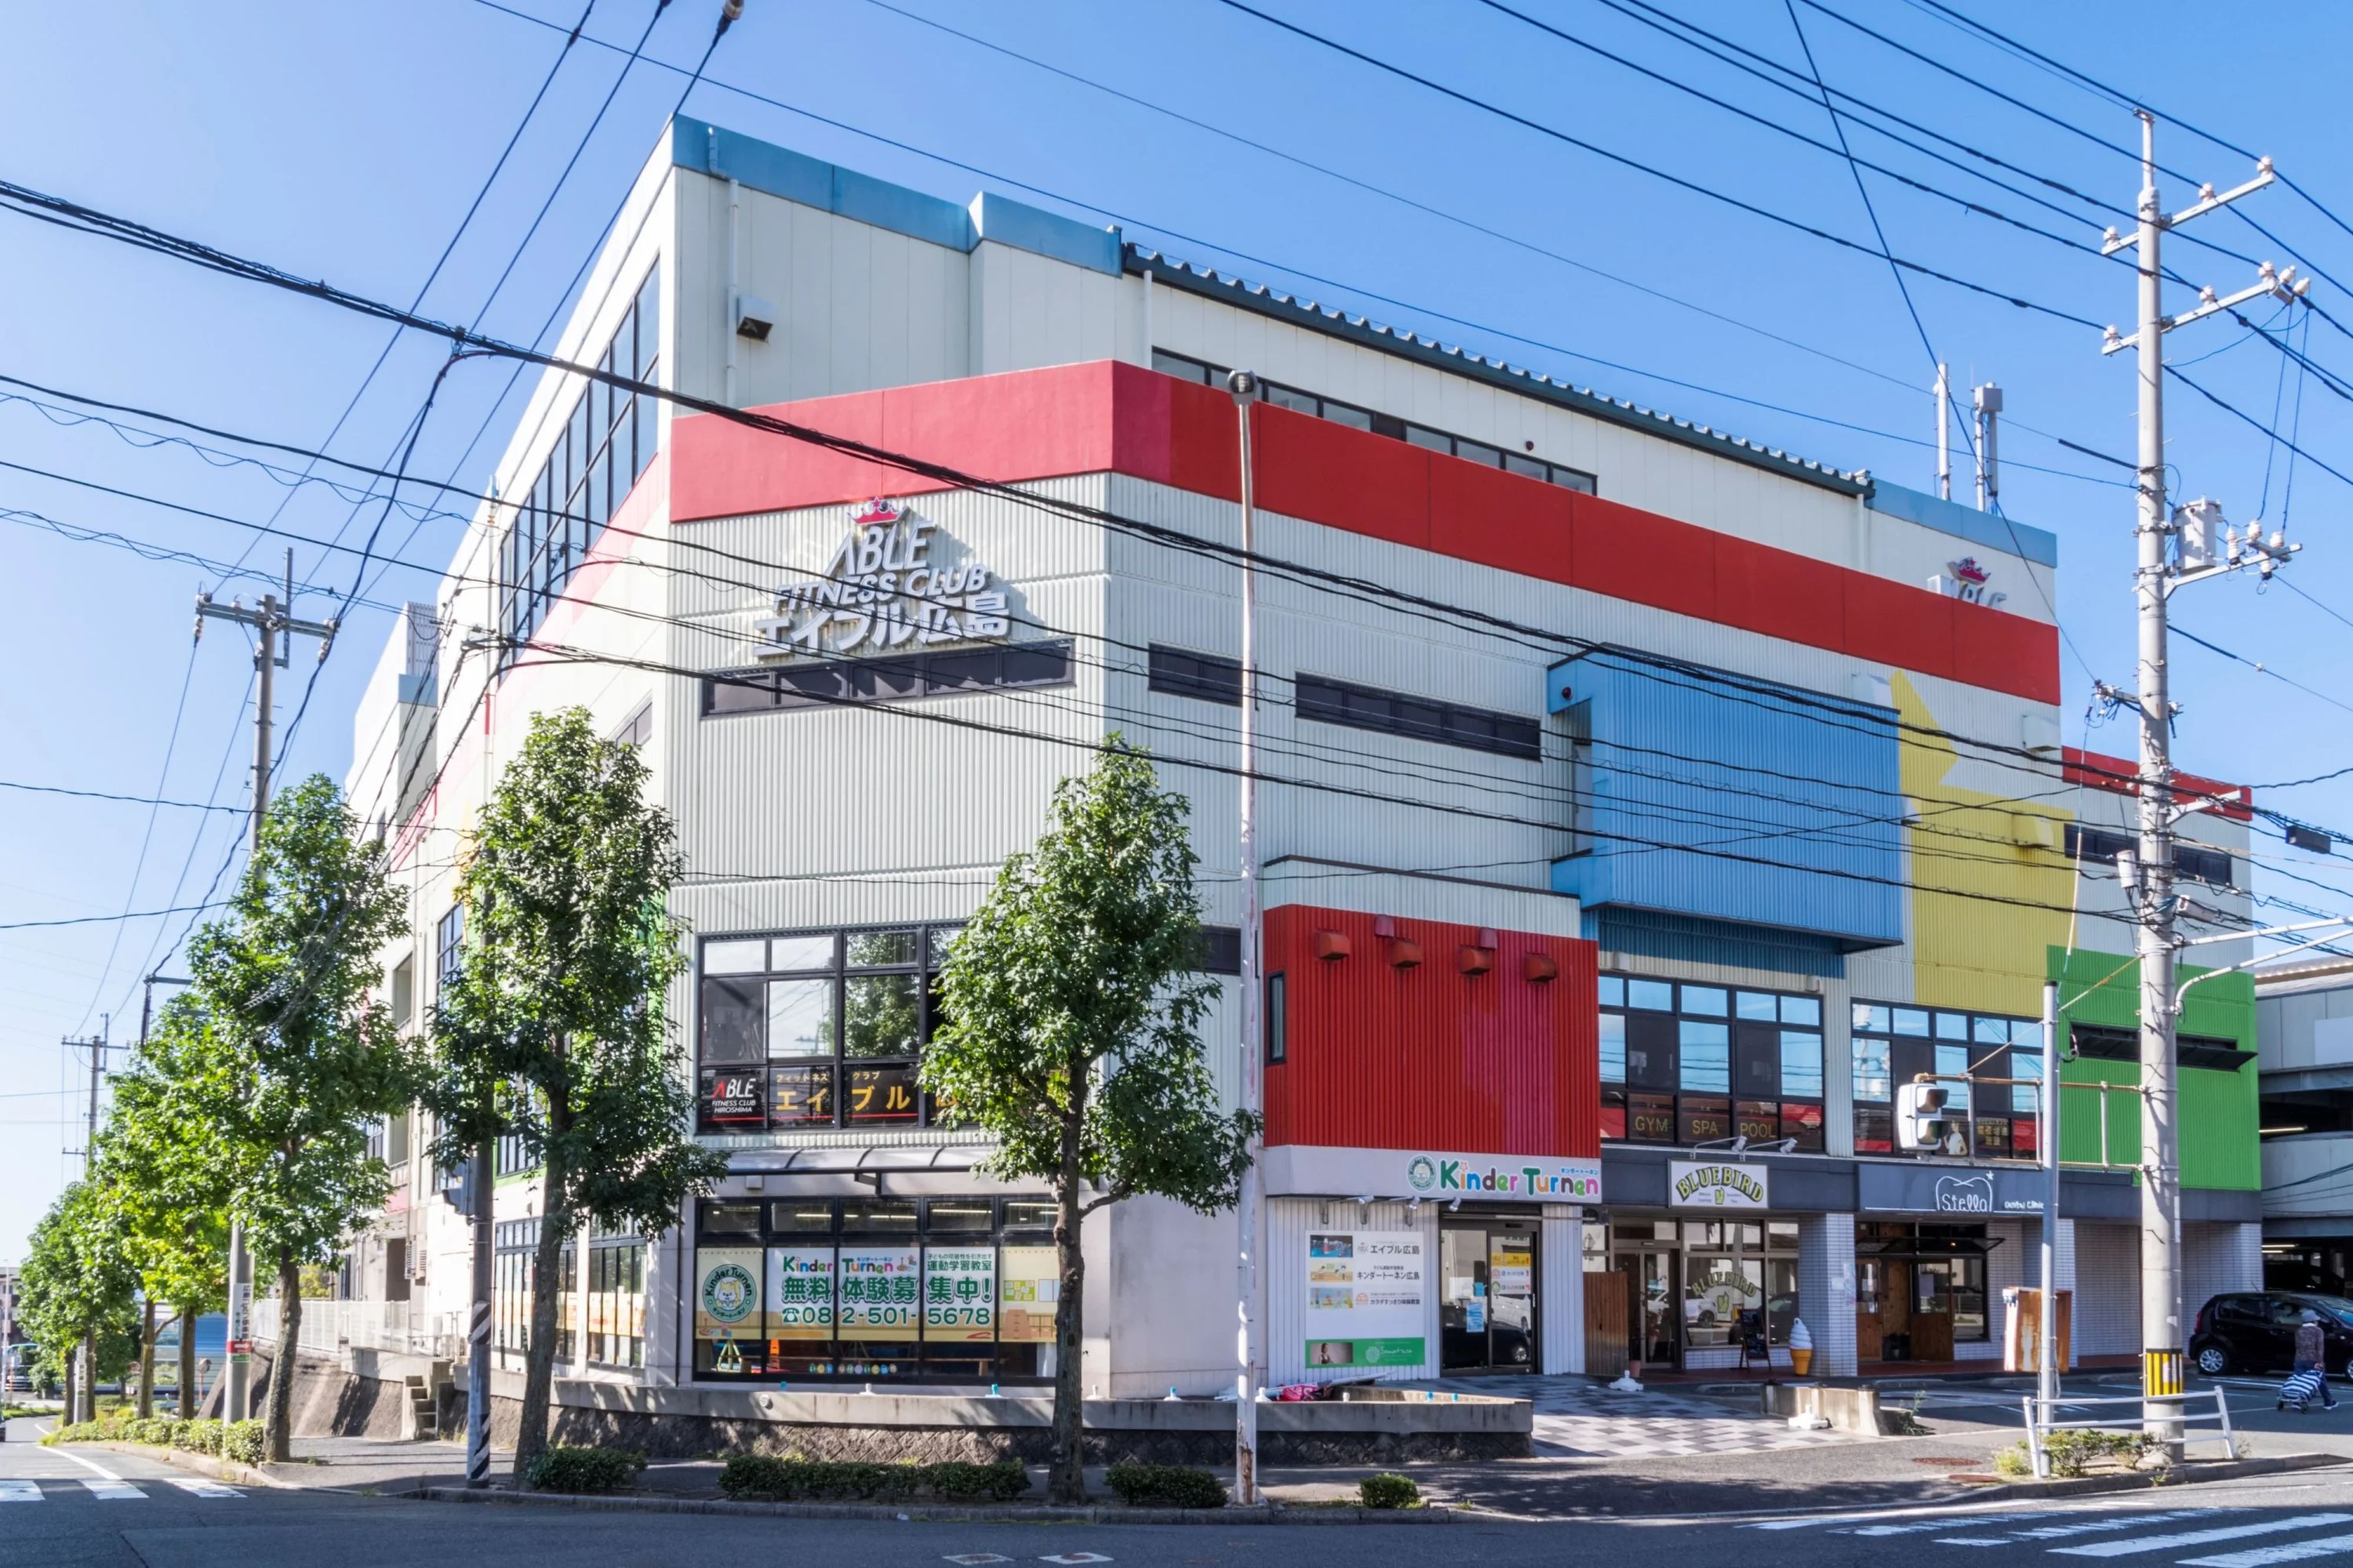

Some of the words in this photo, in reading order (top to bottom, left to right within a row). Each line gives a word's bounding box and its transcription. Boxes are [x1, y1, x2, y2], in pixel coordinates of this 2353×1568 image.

[825, 520, 936, 577] ABLE
[773, 572, 896, 613] FITNESS
[904, 563, 987, 598] CLUB
[753, 590, 1010, 657] エイブル広島
[712, 1078, 756, 1099] ABLE
[1635, 1116, 1668, 1132] GYM
[1692, 1119, 1718, 1135] SPA
[1740, 1122, 1777, 1138] POOL
[1440, 1159, 1518, 1191] Kinder
[1522, 1167, 1598, 1196] Turnen
[1942, 1193, 1988, 1212] Stella
[1370, 1245, 1420, 1254] エイブル広島
[784, 1256, 833, 1272] Kinder
[842, 1258, 893, 1274] Turnen
[928, 1261, 992, 1271] 運動学習教室
[1357, 1271, 1420, 1280] キンダートーネン広島
[705, 1269, 729, 1297] Kinder
[730, 1267, 752, 1296] Turnen
